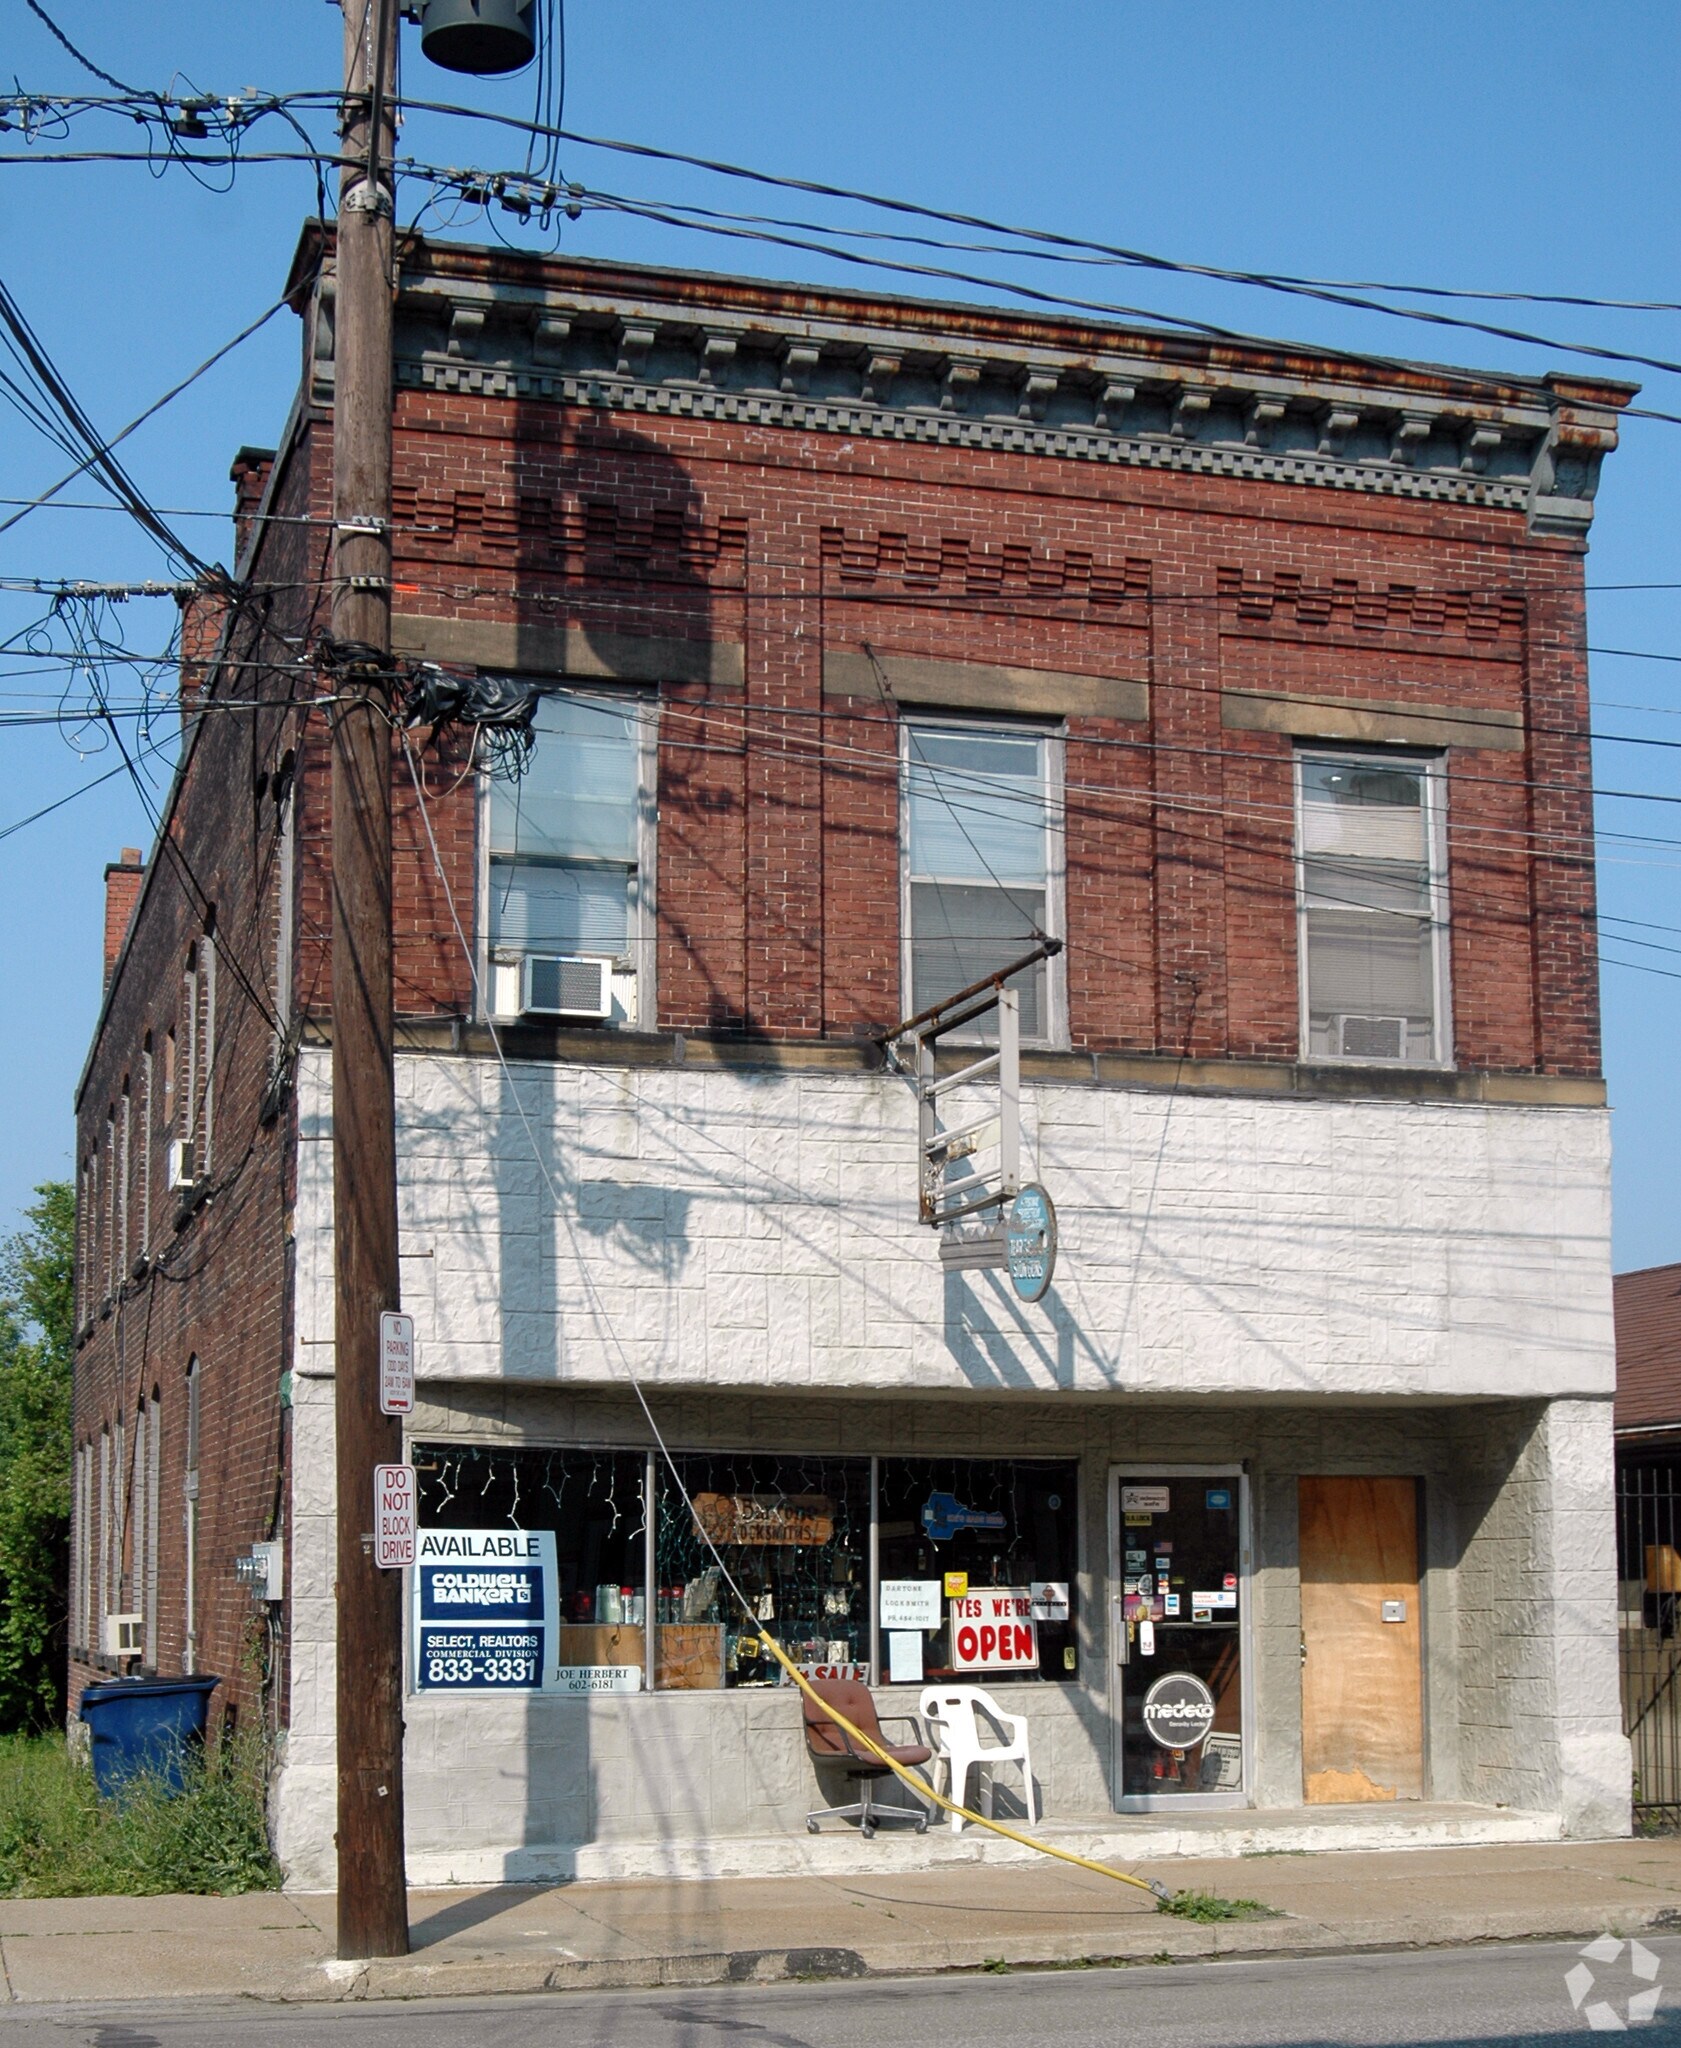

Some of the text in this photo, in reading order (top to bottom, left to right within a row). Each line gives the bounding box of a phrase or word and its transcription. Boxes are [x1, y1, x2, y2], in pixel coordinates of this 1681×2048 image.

[393, 1320, 402, 1336] NO
[386, 1340, 409, 1356] PARKING
[386, 1471, 406, 1489] DO
[383, 1492, 411, 1511] NOT
[383, 1516, 411, 1536] BLOCK
[382, 1540, 412, 1560] DRIVE
[421, 1536, 541, 1557] AVAILABLE
[955, 1598, 1031, 1618] YES WE'RE
[427, 1635, 538, 1649] SELECT, REALTORS
[957, 1624, 1033, 1662] OPEN
[426, 1650, 539, 1659] COMMERCIAL DIVISION
[428, 1658, 536, 1682] 833-3331
[555, 1669, 629, 1681] JOE HERBERT
[815, 1664, 867, 1682] SALE
[568, 1680, 614, 1690] 602-6181
[1143, 1698, 1215, 1719] medeco
